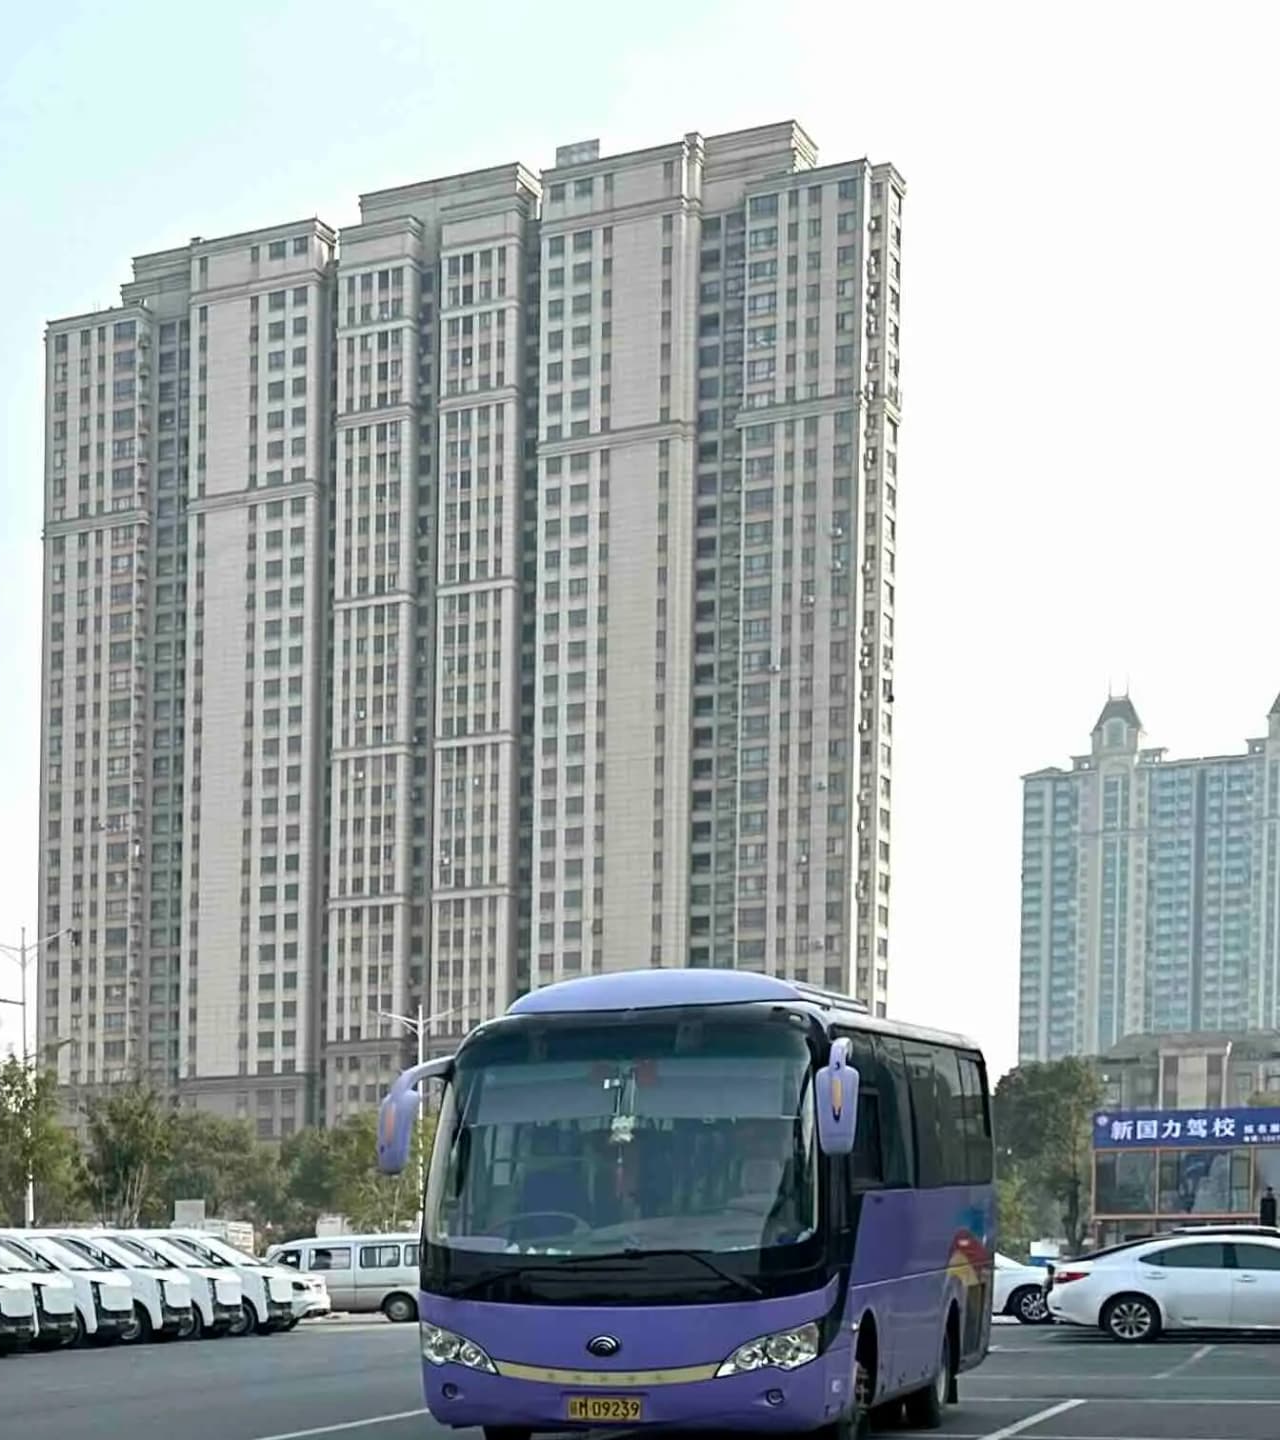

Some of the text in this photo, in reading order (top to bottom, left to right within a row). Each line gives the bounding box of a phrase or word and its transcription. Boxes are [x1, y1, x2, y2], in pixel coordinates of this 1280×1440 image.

[1111, 1118, 1235, 1140] 新国力驾校
